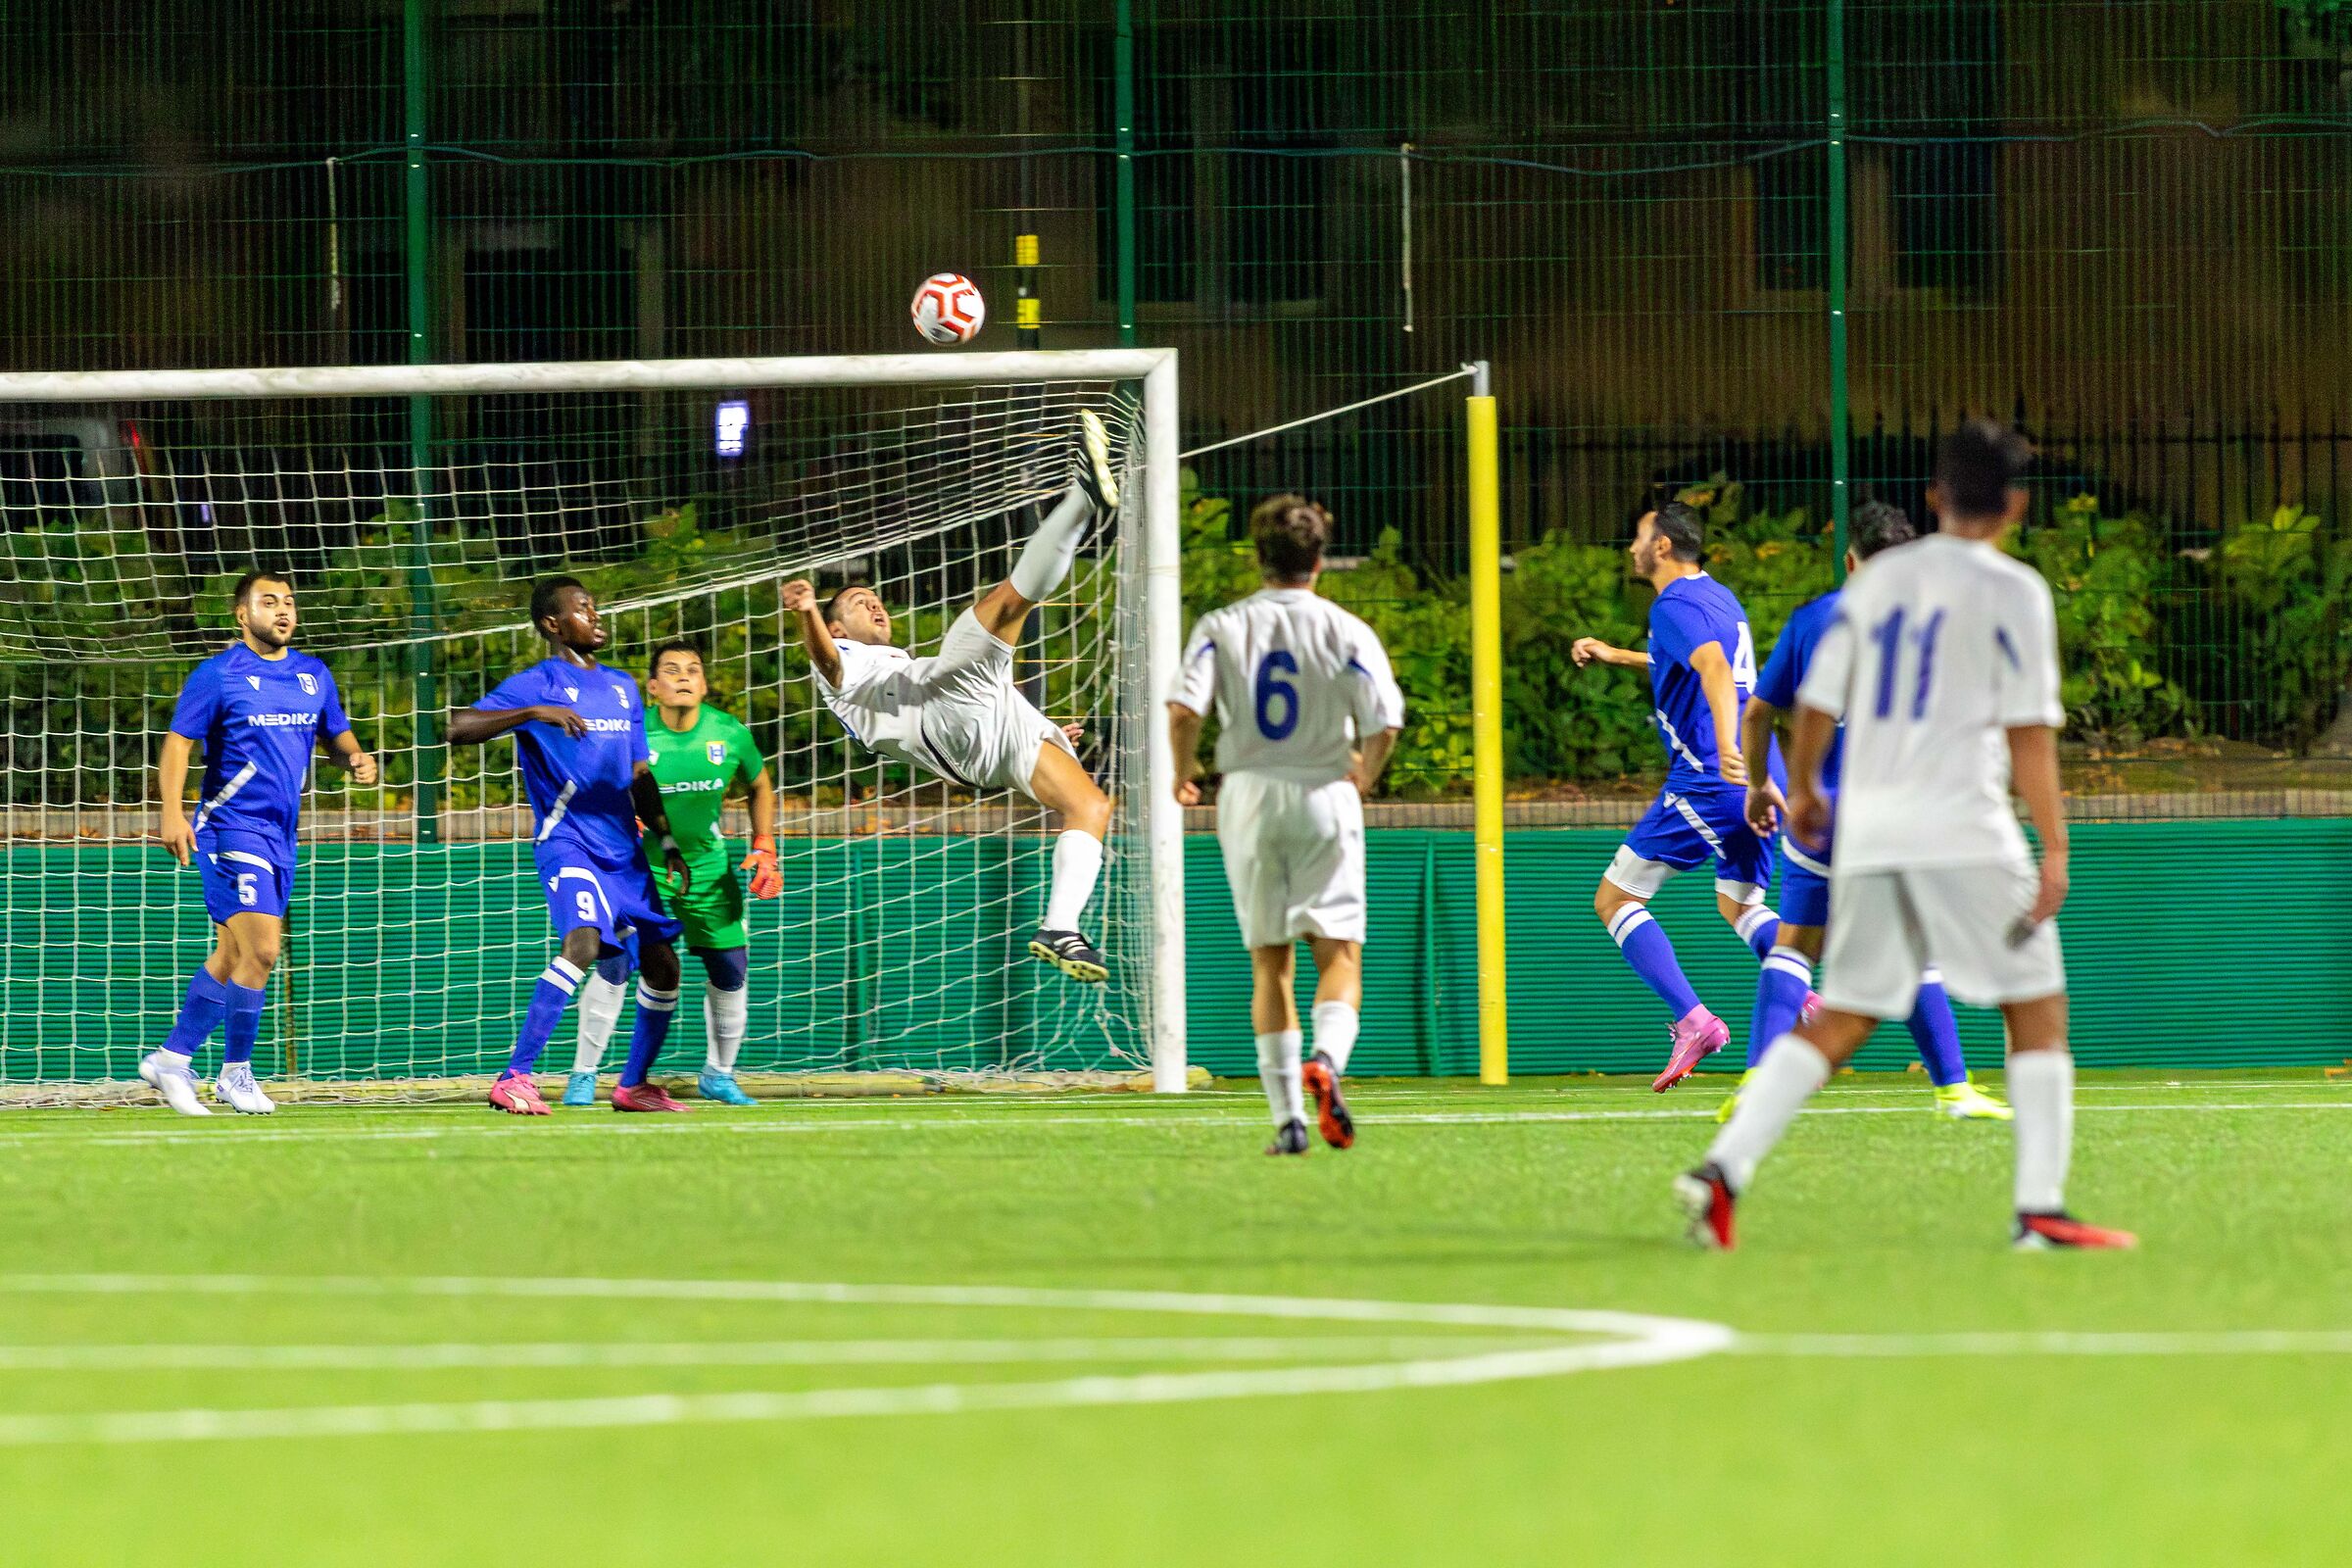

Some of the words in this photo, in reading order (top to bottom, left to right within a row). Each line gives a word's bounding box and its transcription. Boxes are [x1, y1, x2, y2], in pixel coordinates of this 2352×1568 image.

[1732, 620, 1757, 695] 4
[1869, 607, 1944, 720] 11
[1255, 651, 1298, 741] 6
[248, 712, 318, 727] MEDIKA
[581, 718, 631, 732] EDIKA
[658, 777, 724, 795] EDIKA
[237, 873, 258, 906] 5
[575, 891, 598, 922] 9
